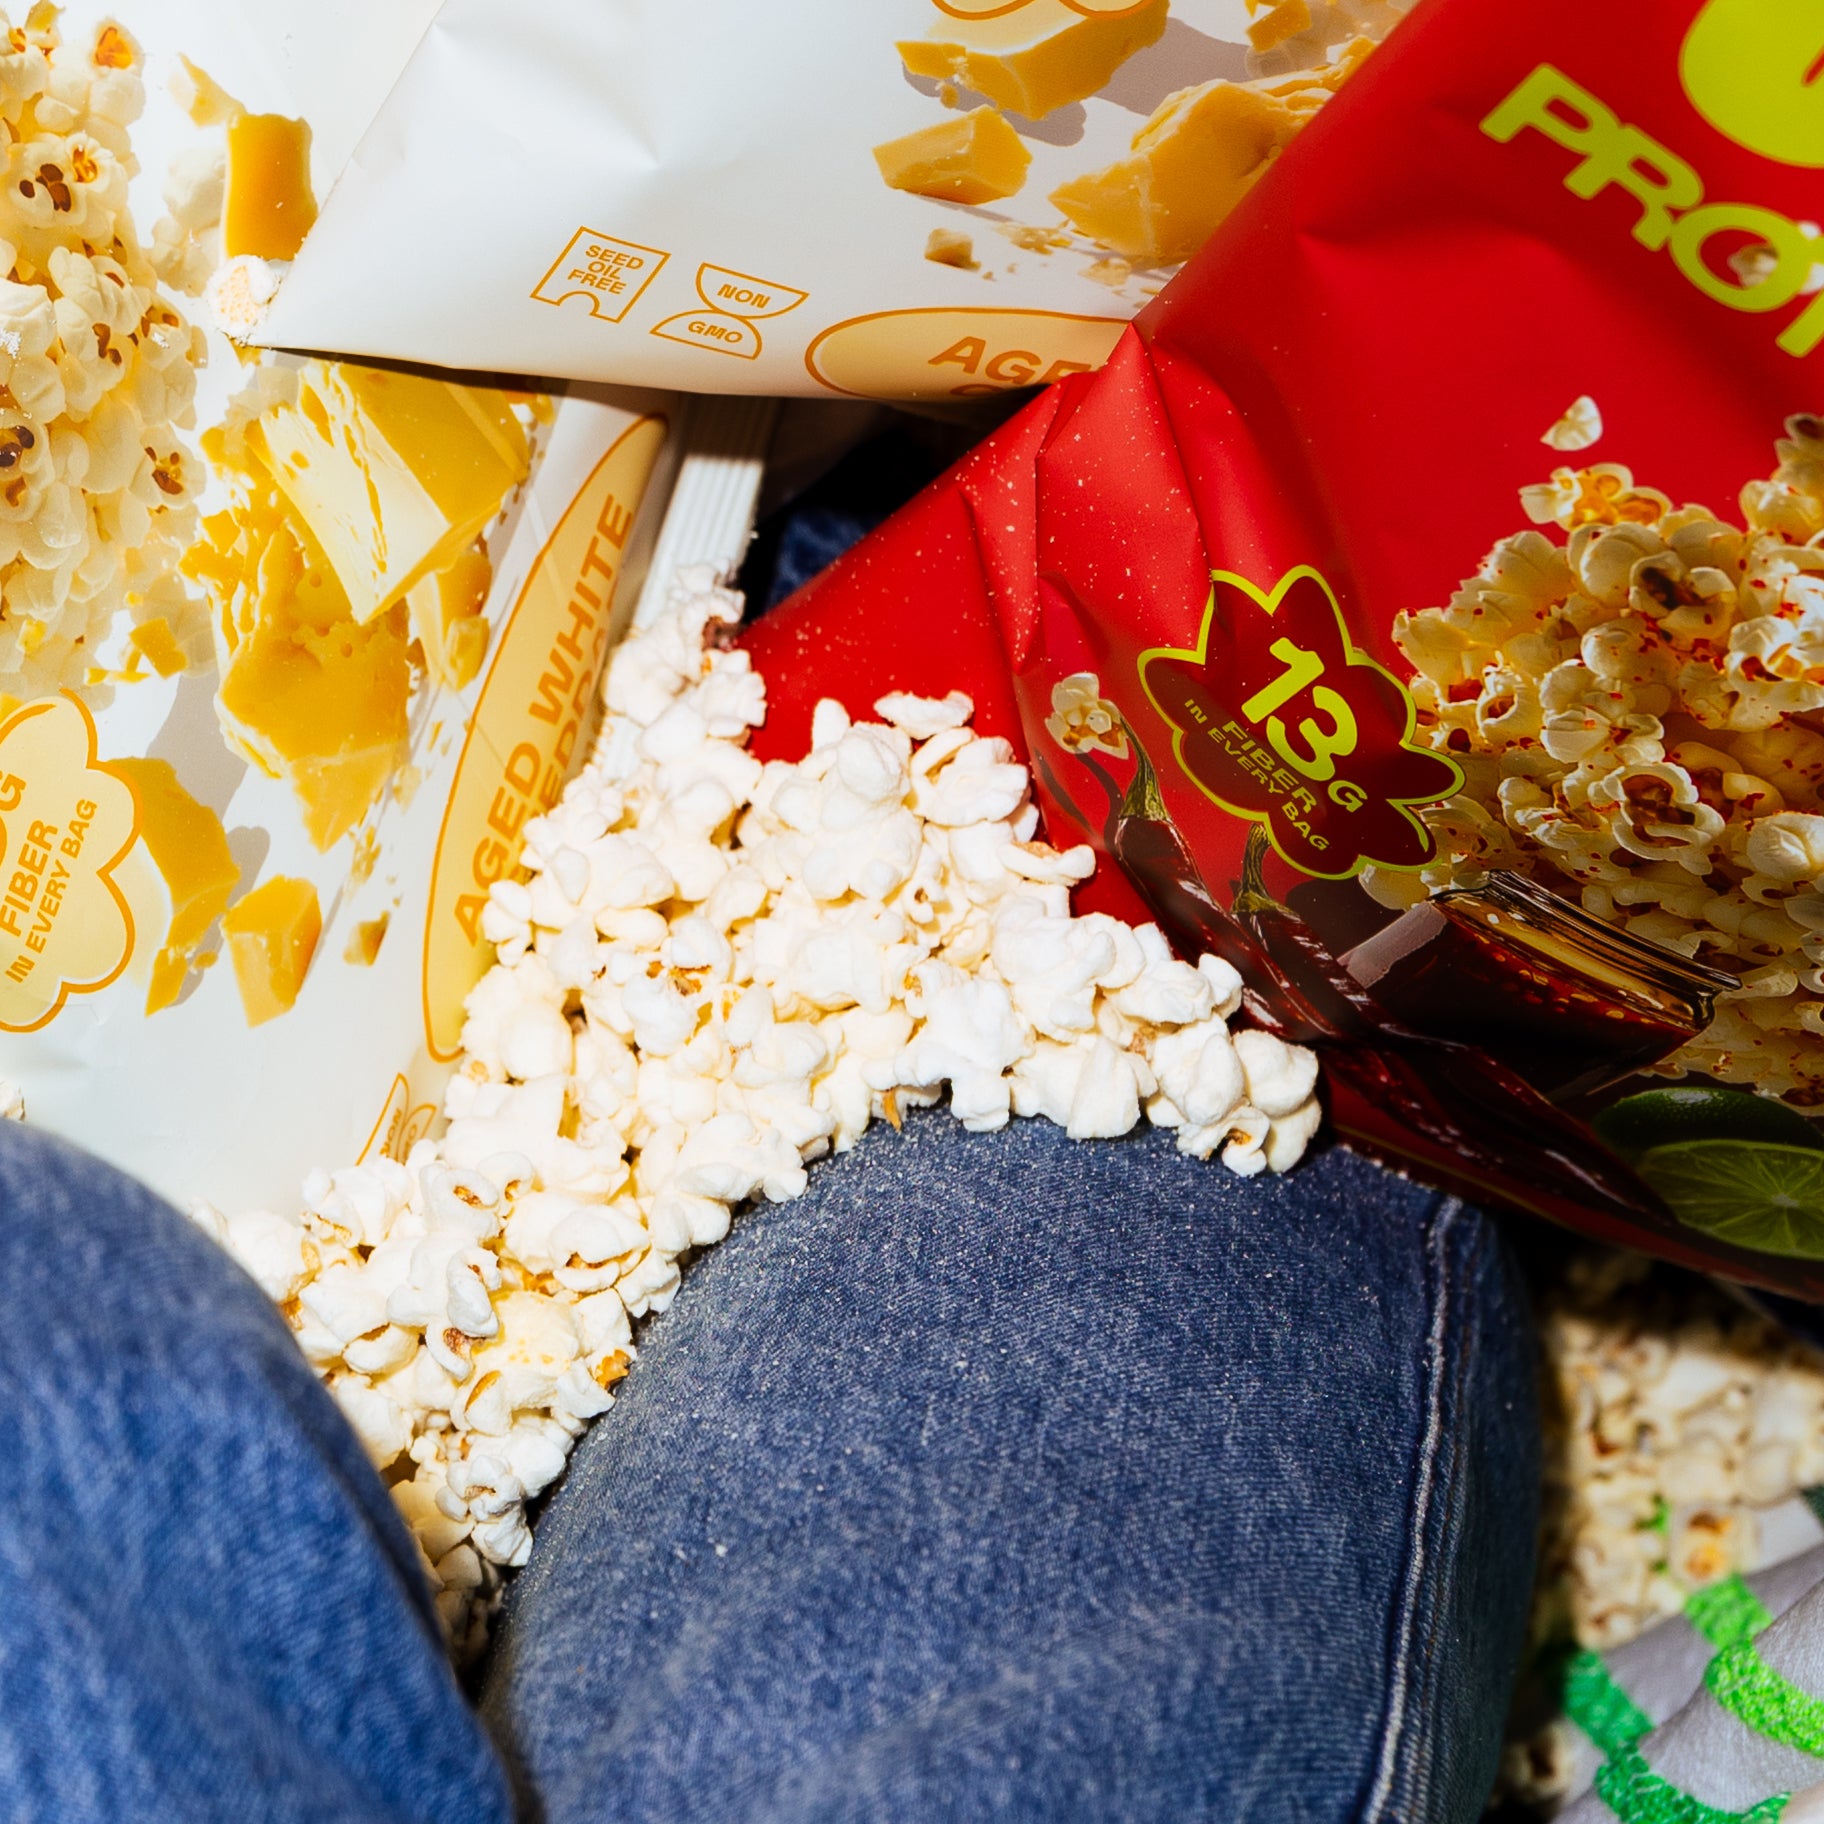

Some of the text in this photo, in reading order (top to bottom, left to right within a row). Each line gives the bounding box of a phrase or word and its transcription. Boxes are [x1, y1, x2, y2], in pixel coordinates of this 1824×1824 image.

[584, 243, 645, 271] SEED
[586, 260, 623, 281] OIL
[566, 268, 627, 296] FREE
[716, 283, 772, 309] NON
[687, 319, 744, 345] GMO
[453, 741, 549, 951] AGED
[527, 491, 640, 751] WHITE
[1184, 699, 1329, 850] IN EVERY BAG
[1222, 720, 1317, 814] FIBER
[4, 799, 98, 984] IN EVERY BAG
